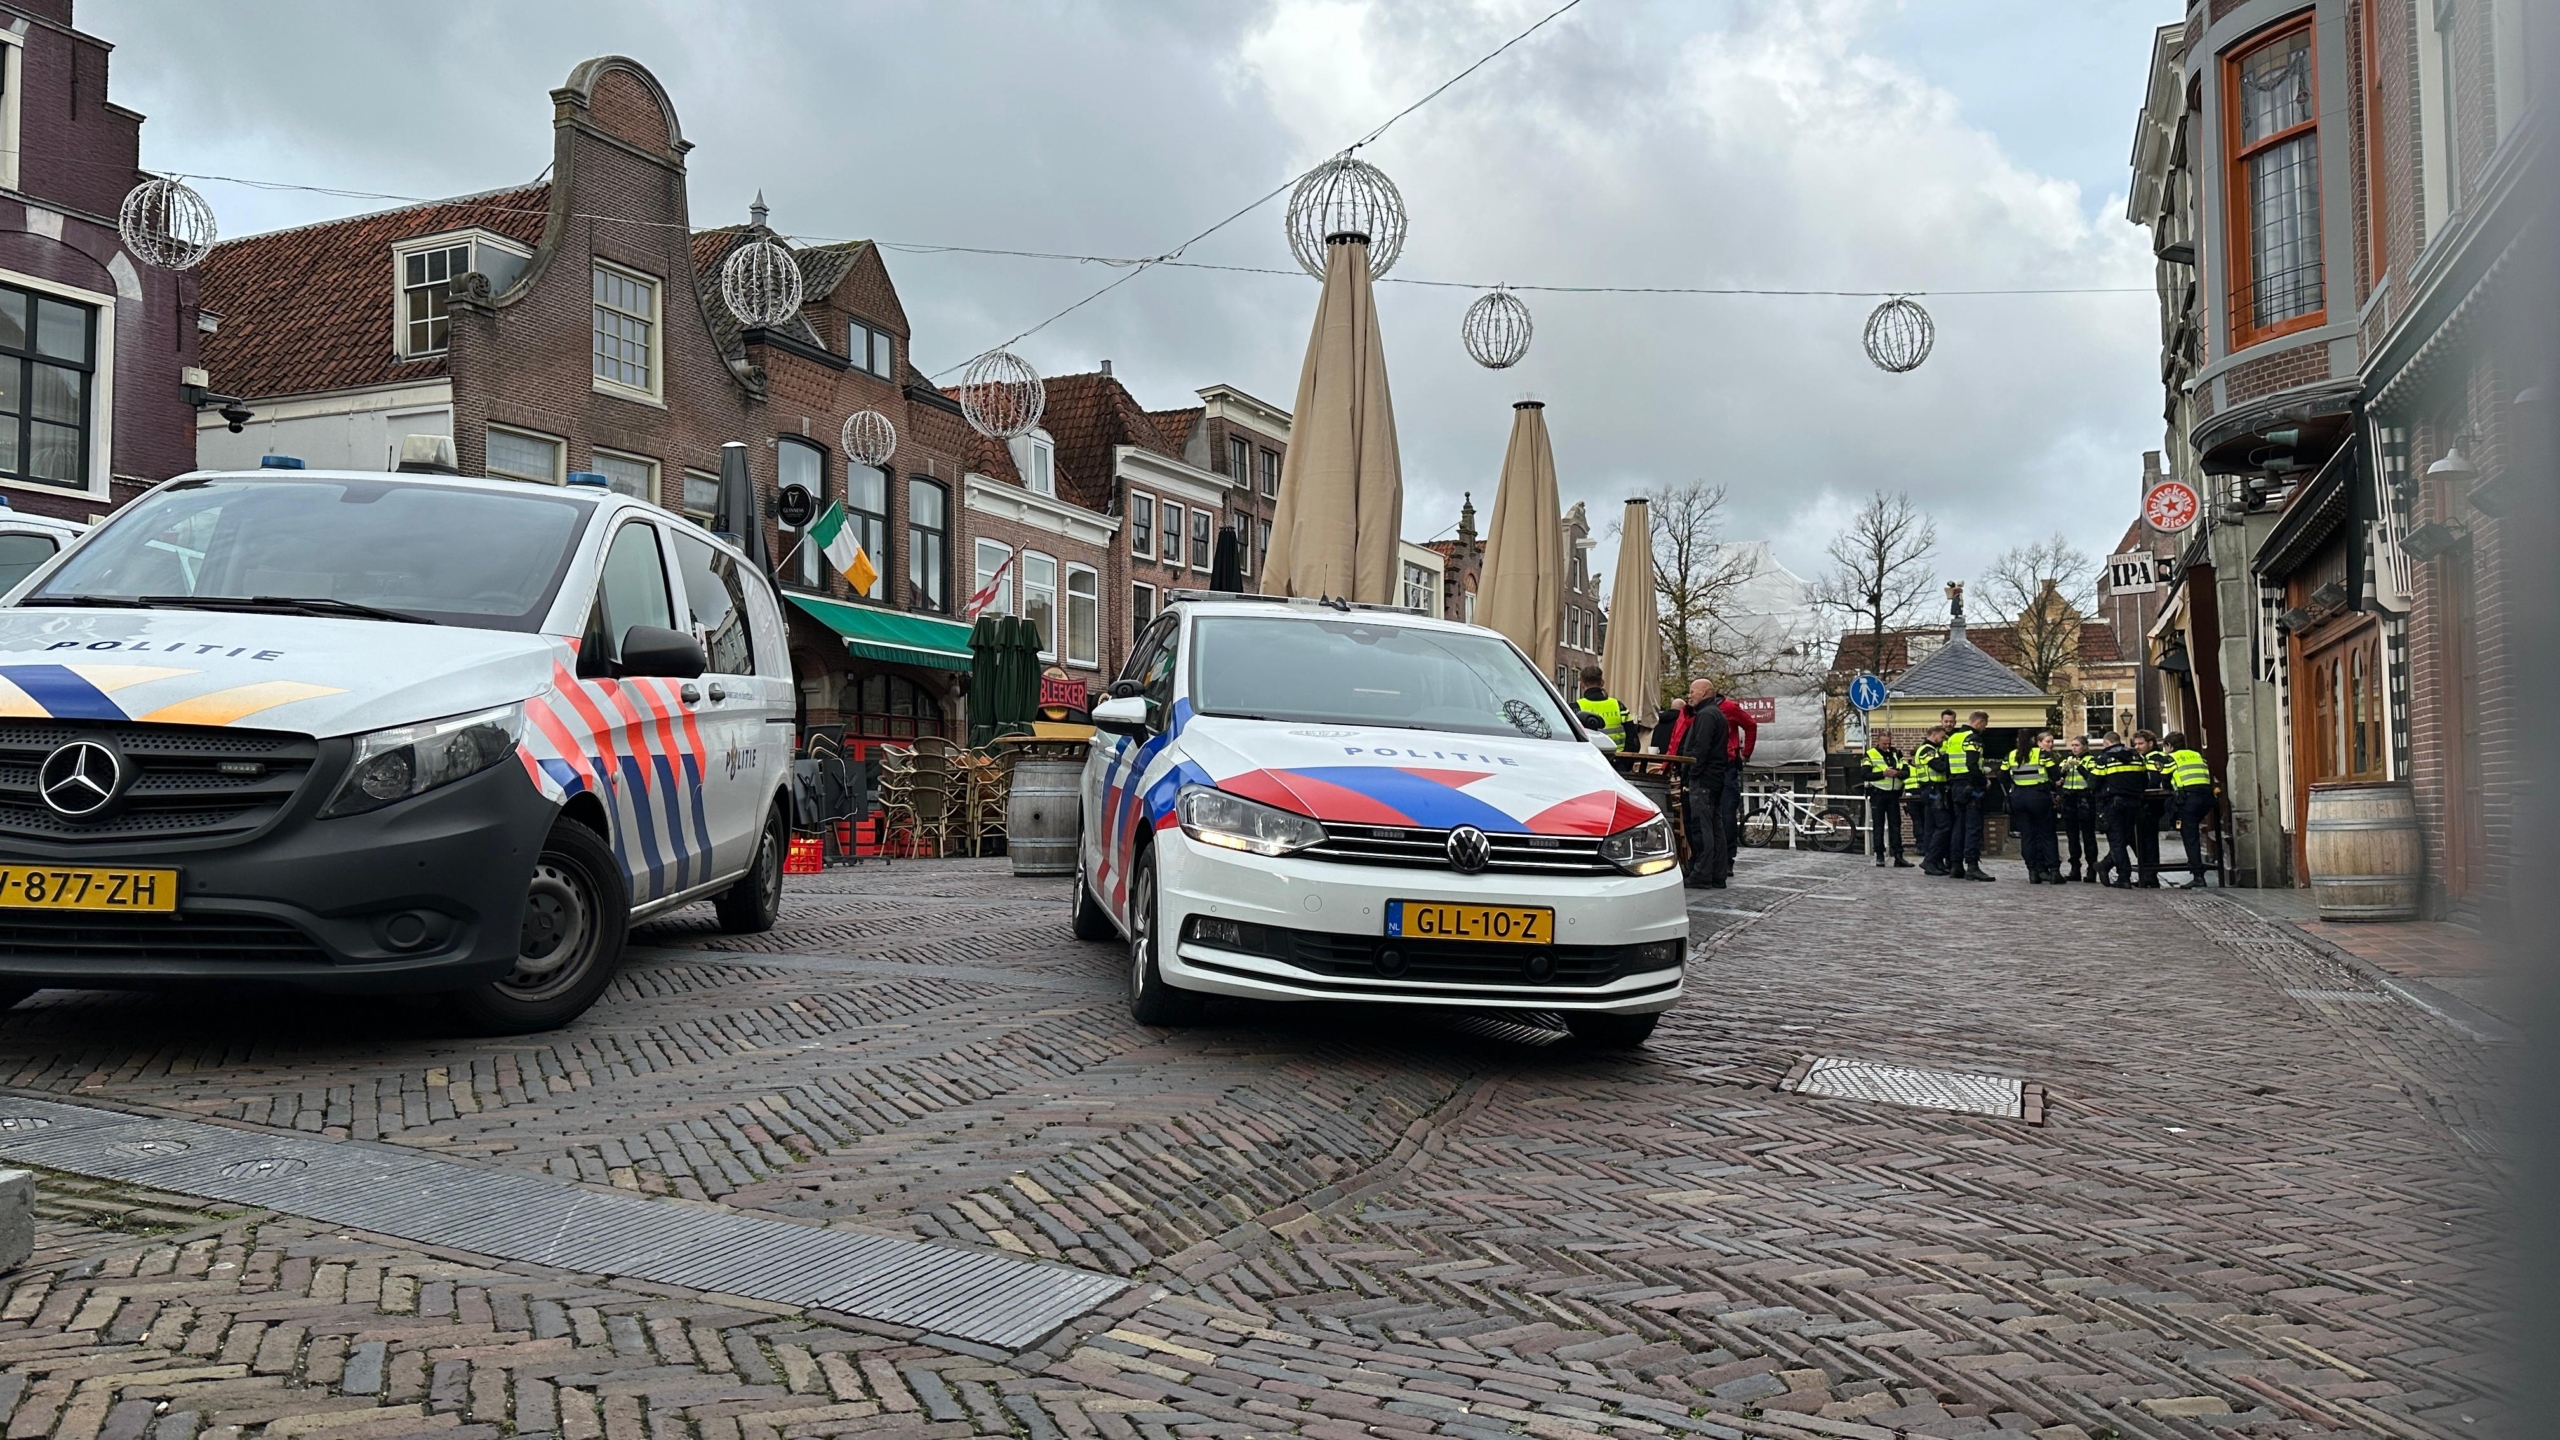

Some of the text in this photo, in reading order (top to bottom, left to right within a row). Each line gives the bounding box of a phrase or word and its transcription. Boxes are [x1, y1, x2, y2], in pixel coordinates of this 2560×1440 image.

[2161, 514, 2188, 528] Bier
[2111, 561, 2153, 587] IPA
[45, 640, 285, 661] POLITIE
[1040, 679, 1086, 711] BLEEKER
[725, 742, 757, 781] POLITIE
[1343, 747, 1519, 766] POLITIE
[1388, 922, 1400, 931] NL
[1417, 908, 1538, 938] GLL-10-Z
